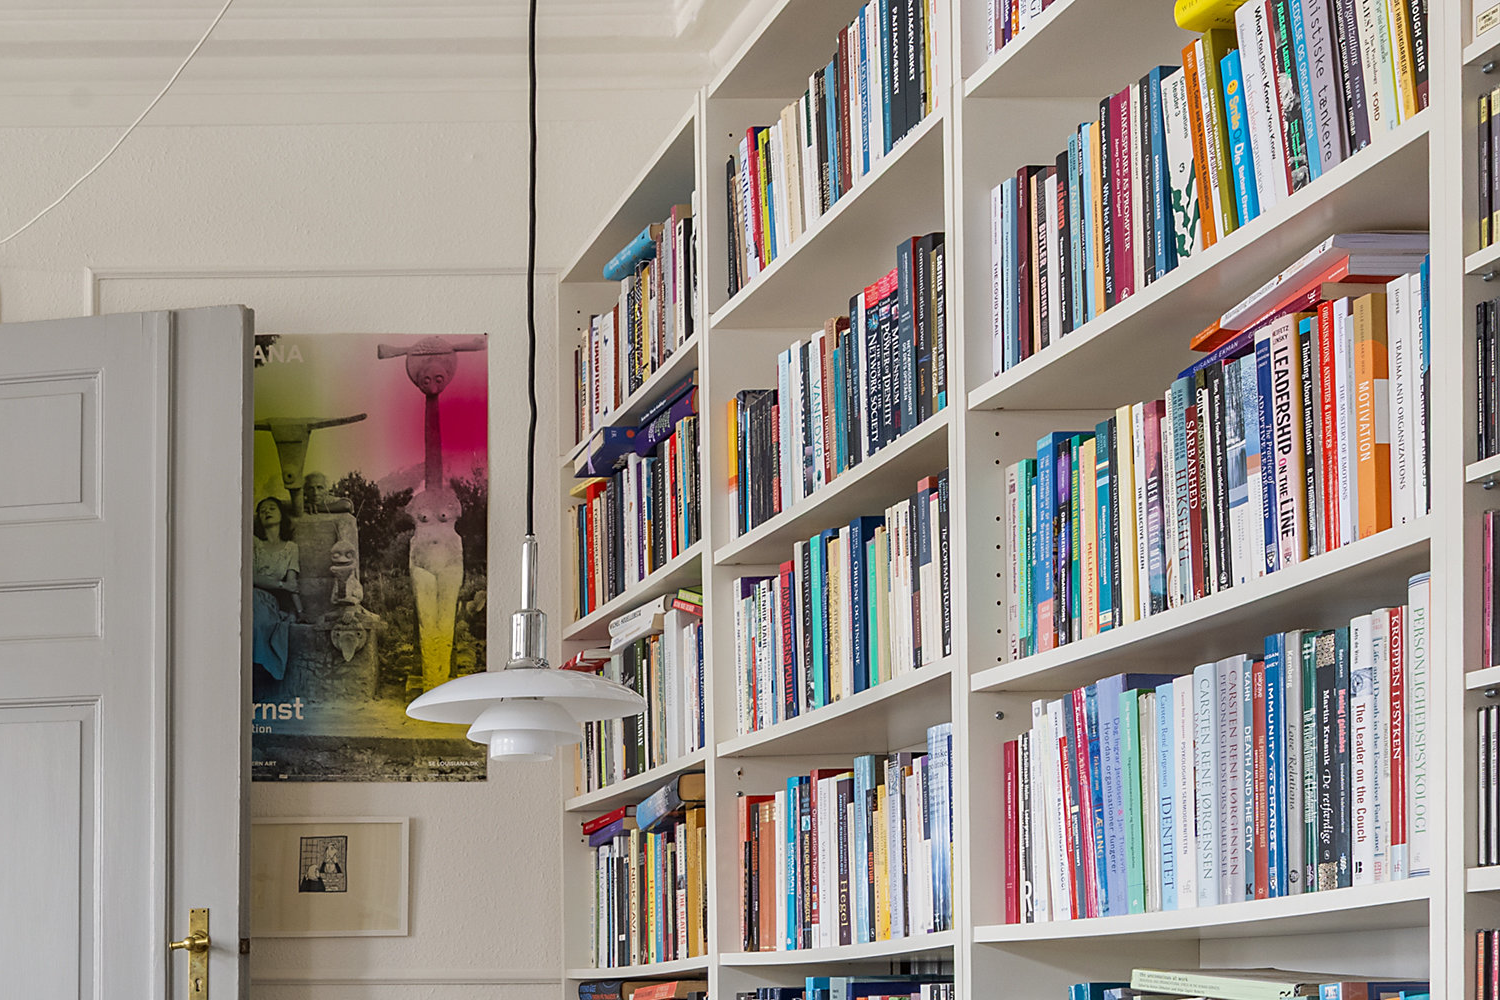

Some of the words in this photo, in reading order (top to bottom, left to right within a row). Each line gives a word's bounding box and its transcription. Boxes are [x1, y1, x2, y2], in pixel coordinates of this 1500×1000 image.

[1255, 6, 1265, 36] What
[1257, 37, 1265, 54] You
[1415, 40, 1425, 72] CRISIS
[1260, 56, 1268, 80] Don't
[1230, 98, 1240, 130] Smile
[1262, 82, 1273, 112] Know
[1300, 63, 1314, 138] ORGANISATION
[1372, 92, 1380, 121] FORD
[1120, 101, 1128, 174] SHAKESPEARE
[1233, 128, 1243, 144] Or
[1245, 74, 1254, 92] den
[1252, 134, 1264, 193] organisation
[1318, 85, 1332, 162] tænkere
[1234, 144, 1244, 166] Die
[1038, 223, 1047, 267] BUTLER
[1322, 307, 1330, 365] ORGANISATIONS,
[868, 333, 878, 394] NETWORK
[1301, 341, 1311, 378] Thinking
[1395, 339, 1403, 378] TRAUMA
[1274, 346, 1291, 455] LEADERSHIP
[1303, 380, 1311, 406] About
[1323, 367, 1332, 402] ANXIETIES
[1396, 382, 1404, 404] AND
[813, 380, 822, 459] VANEDYR
[1259, 395, 1267, 451] ADAPTIVE
[1305, 408, 1313, 455] Institutions
[1357, 380, 1371, 461] MOTIVATION
[1186, 421, 1198, 509] SÅRBARHED
[1278, 457, 1288, 473] ON
[1397, 407, 1406, 490] ORGANIZATIONS
[1260, 453, 1269, 518] LEADERSHIP
[1267, 476, 1275, 484] of
[1279, 475, 1288, 496] THE
[1176, 469, 1189, 566] HEKSEHYL
[1280, 498, 1294, 540] LINE
[1392, 615, 1400, 687] KROPPEN
[253, 697, 304, 720] rnst
[1356, 703, 1366, 723] The
[1413, 607, 1425, 833] PERSONLIGHEDSPSYKOLOGI
[1356, 726, 1366, 765] Leader
[1392, 702, 1401, 759] PSYKEN
[1322, 770, 1332, 788] De
[1356, 768, 1365, 782] on
[1357, 786, 1367, 804] the
[1320, 793, 1332, 844] retfærdige
[1357, 808, 1367, 842] Couch
[1161, 796, 1174, 889] IDENTITET
[1245, 826, 1253, 852] CITY
[840, 880, 848, 927] Hegel
